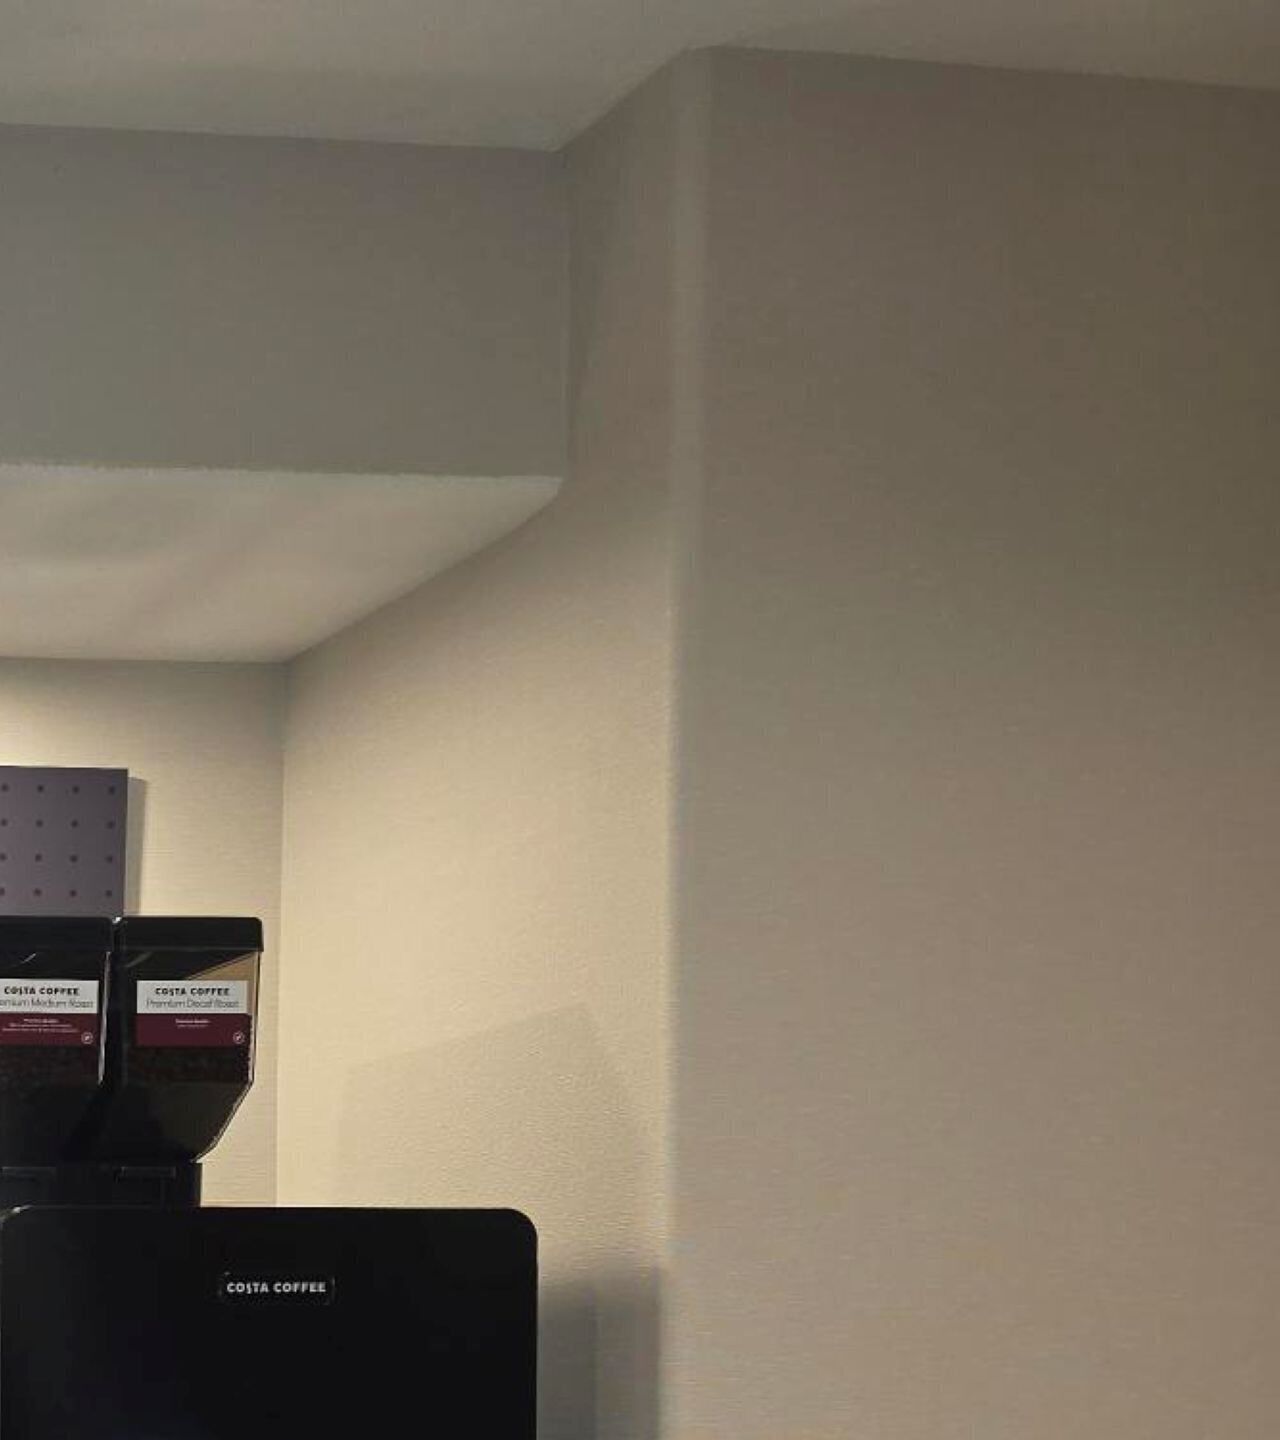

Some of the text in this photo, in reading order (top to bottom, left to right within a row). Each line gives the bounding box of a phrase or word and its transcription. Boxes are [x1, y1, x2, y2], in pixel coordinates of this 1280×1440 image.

[4, 986, 80, 996] COSTA COFFEE
[155, 987, 230, 997] COSTA COFFEE
[226, 1281, 327, 1294] COSTA COFFEE
